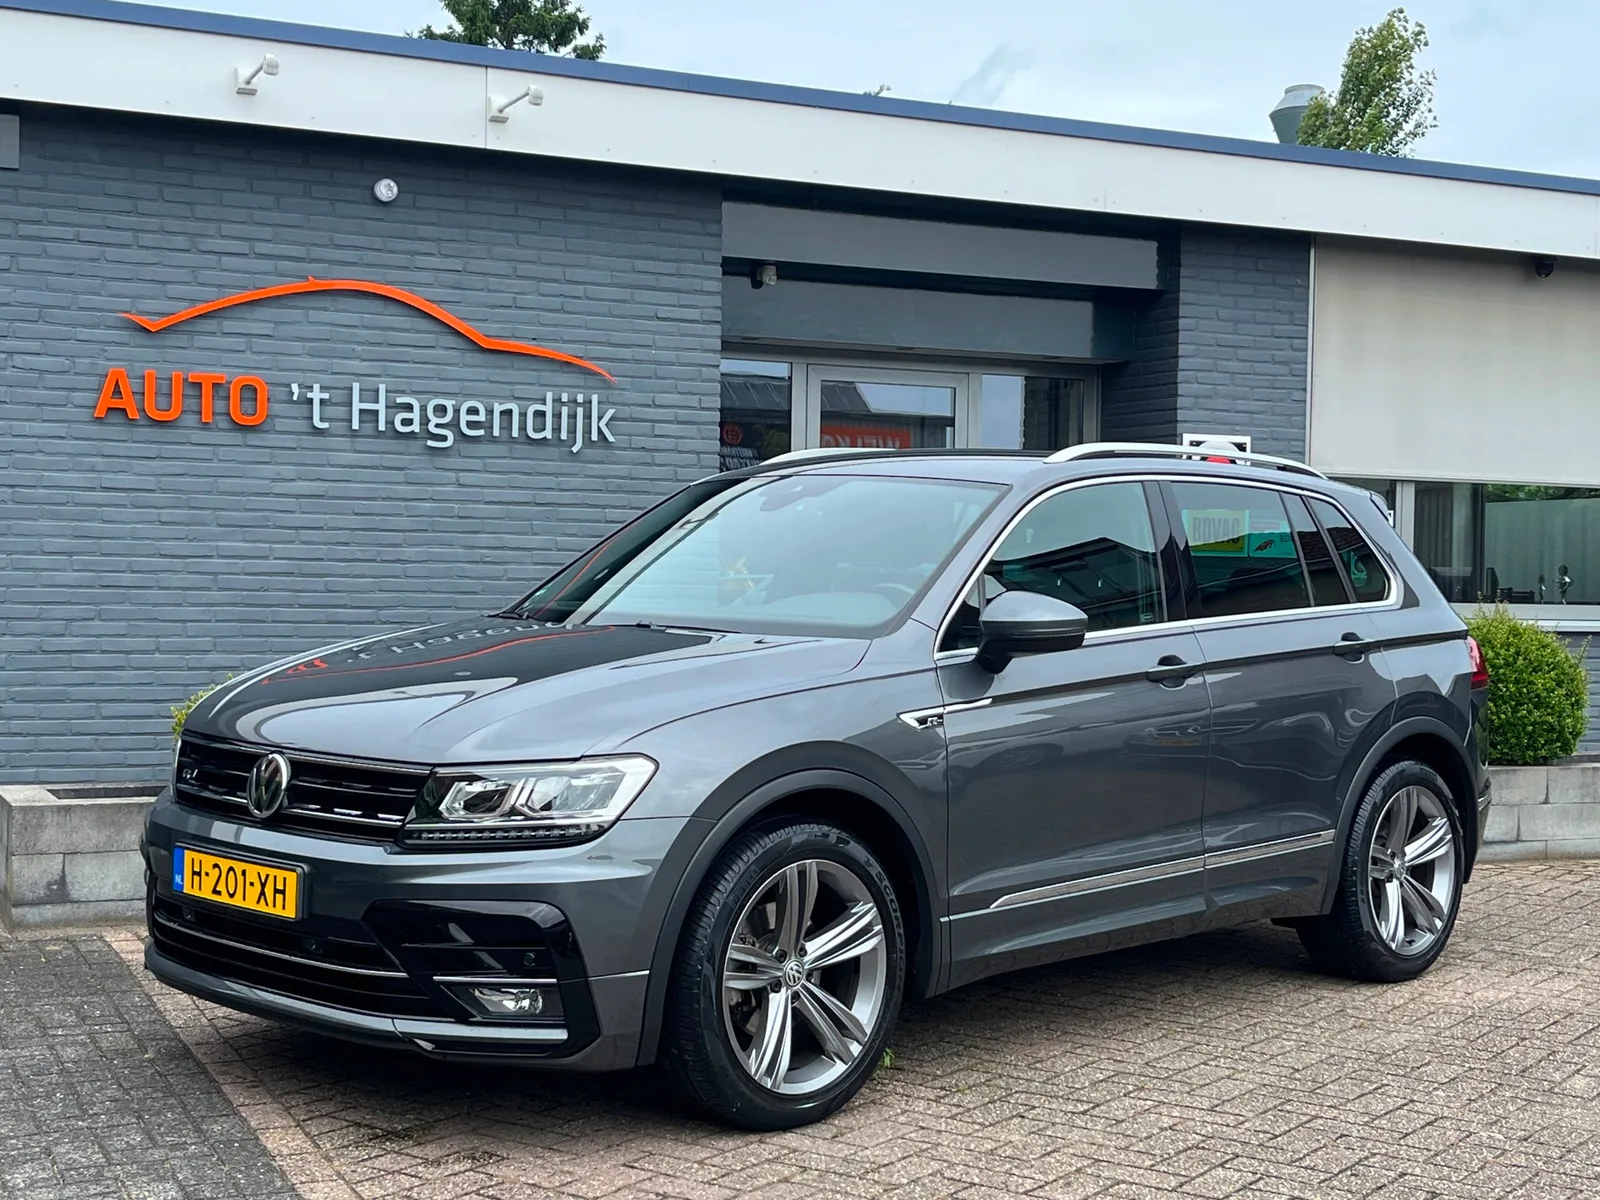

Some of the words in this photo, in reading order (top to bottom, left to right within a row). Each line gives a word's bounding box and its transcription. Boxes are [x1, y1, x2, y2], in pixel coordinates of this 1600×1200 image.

[94, 368, 269, 427] AUTO
[291, 382, 331, 430] 't
[351, 382, 616, 454] Hagendijk
[175, 874, 184, 885] NL
[191, 857, 287, 911] H-201-XH
